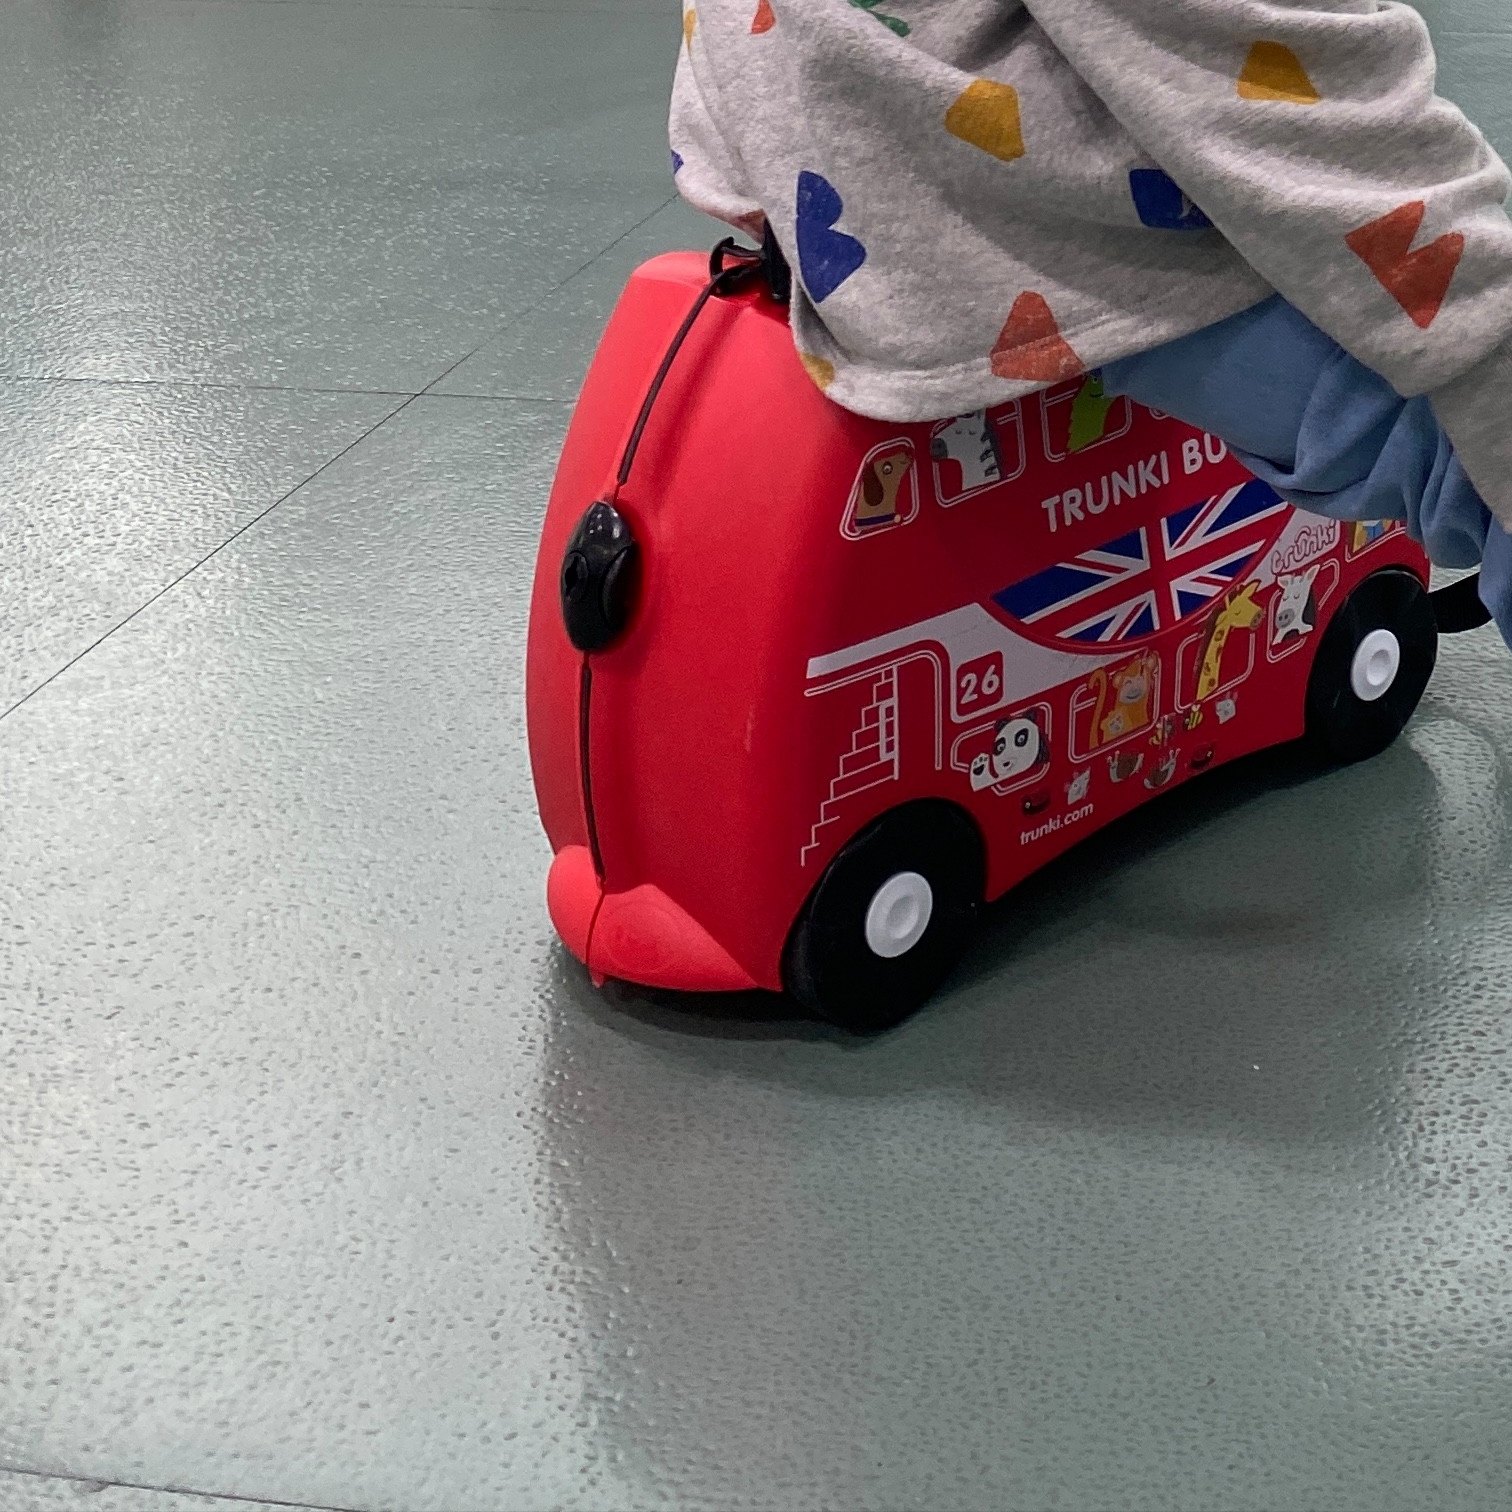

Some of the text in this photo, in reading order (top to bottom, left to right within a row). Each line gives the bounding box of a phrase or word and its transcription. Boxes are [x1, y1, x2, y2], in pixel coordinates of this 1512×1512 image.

[1041, 432, 1228, 533] TRUNKI BU
[960, 664, 1000, 705] 26
[1020, 803, 1095, 846] trunki.com
